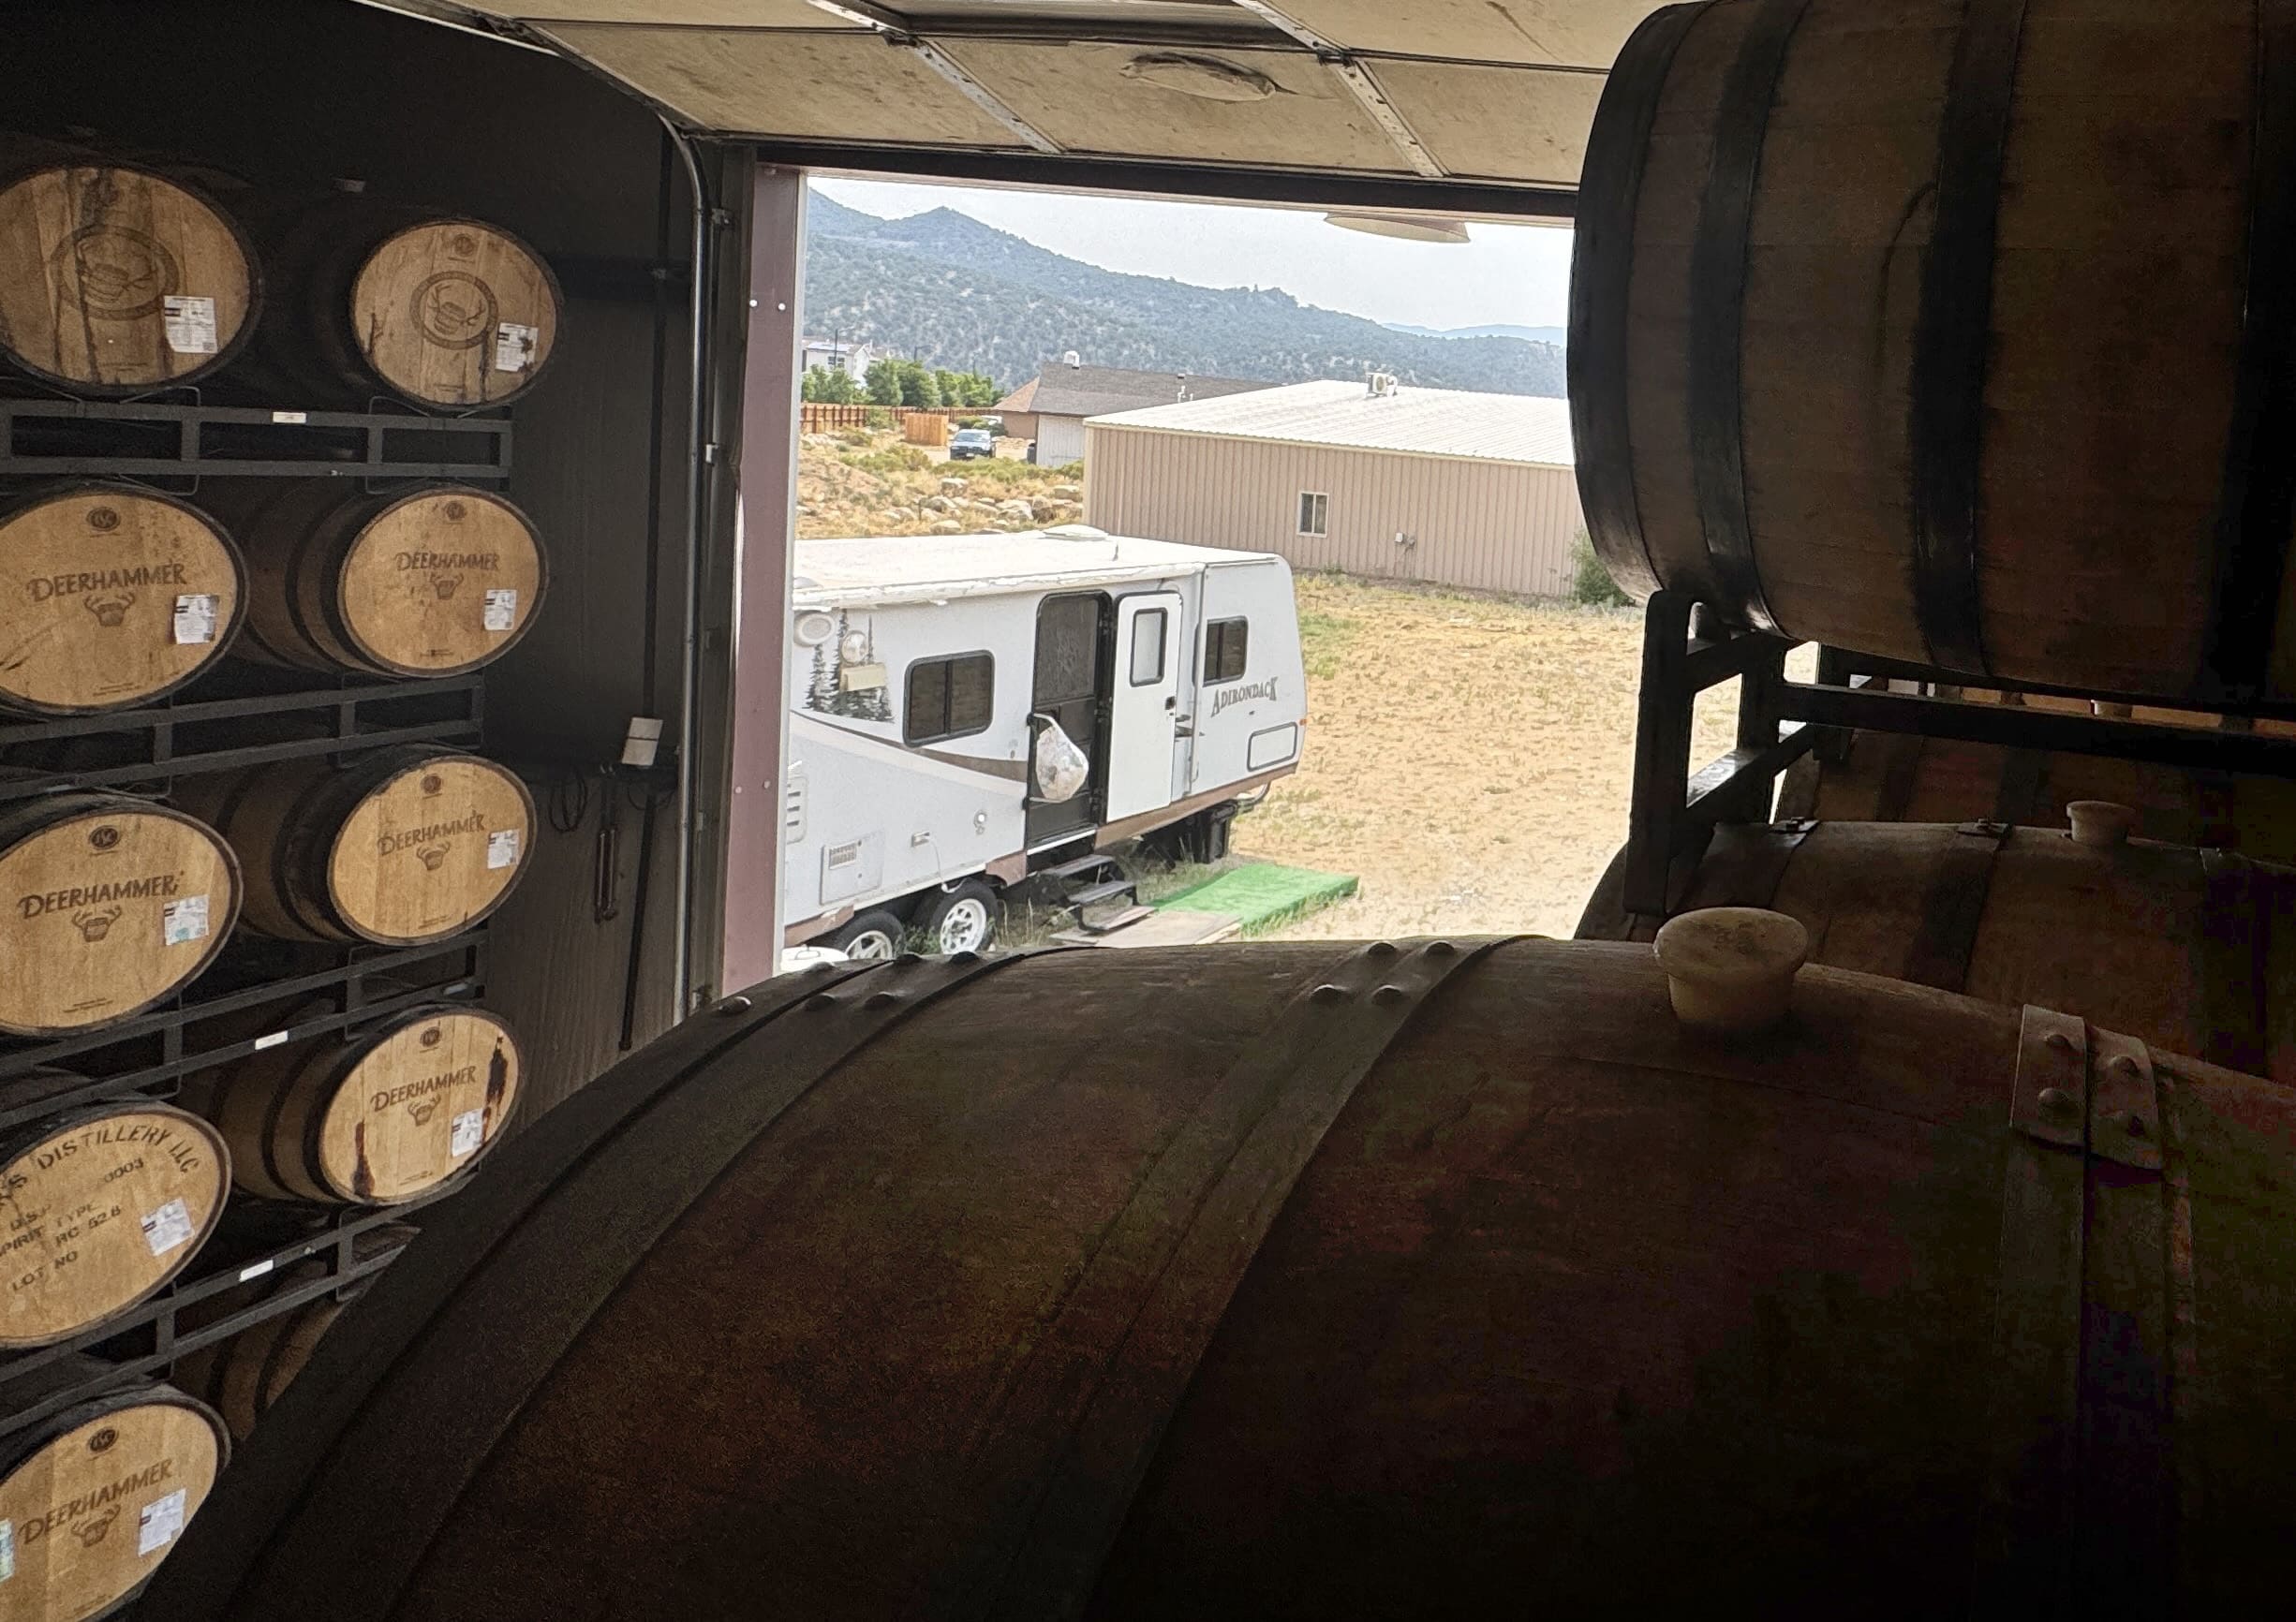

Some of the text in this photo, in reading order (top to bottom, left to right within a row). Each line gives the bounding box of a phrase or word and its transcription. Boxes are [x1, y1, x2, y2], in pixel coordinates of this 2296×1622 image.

[26, 562, 187, 602] DEERHAMMER
[393, 551, 500, 572] DEERHAMMER
[1211, 677, 1278, 717] ADIRONDACK
[377, 812, 486, 856] DEERHAMMER
[18, 875, 178, 920] DEERHAMMER
[370, 1066, 476, 1113] DEERHAMMER
[37, 1125, 172, 1170] DISTILLERY
[169, 1140, 200, 1174] LLC
[0, 1200, 99, 1257] PIRIT TYPE
[12, 1265, 46, 1291] LOT
[17, 1458, 173, 1545] DEERHAMMER
